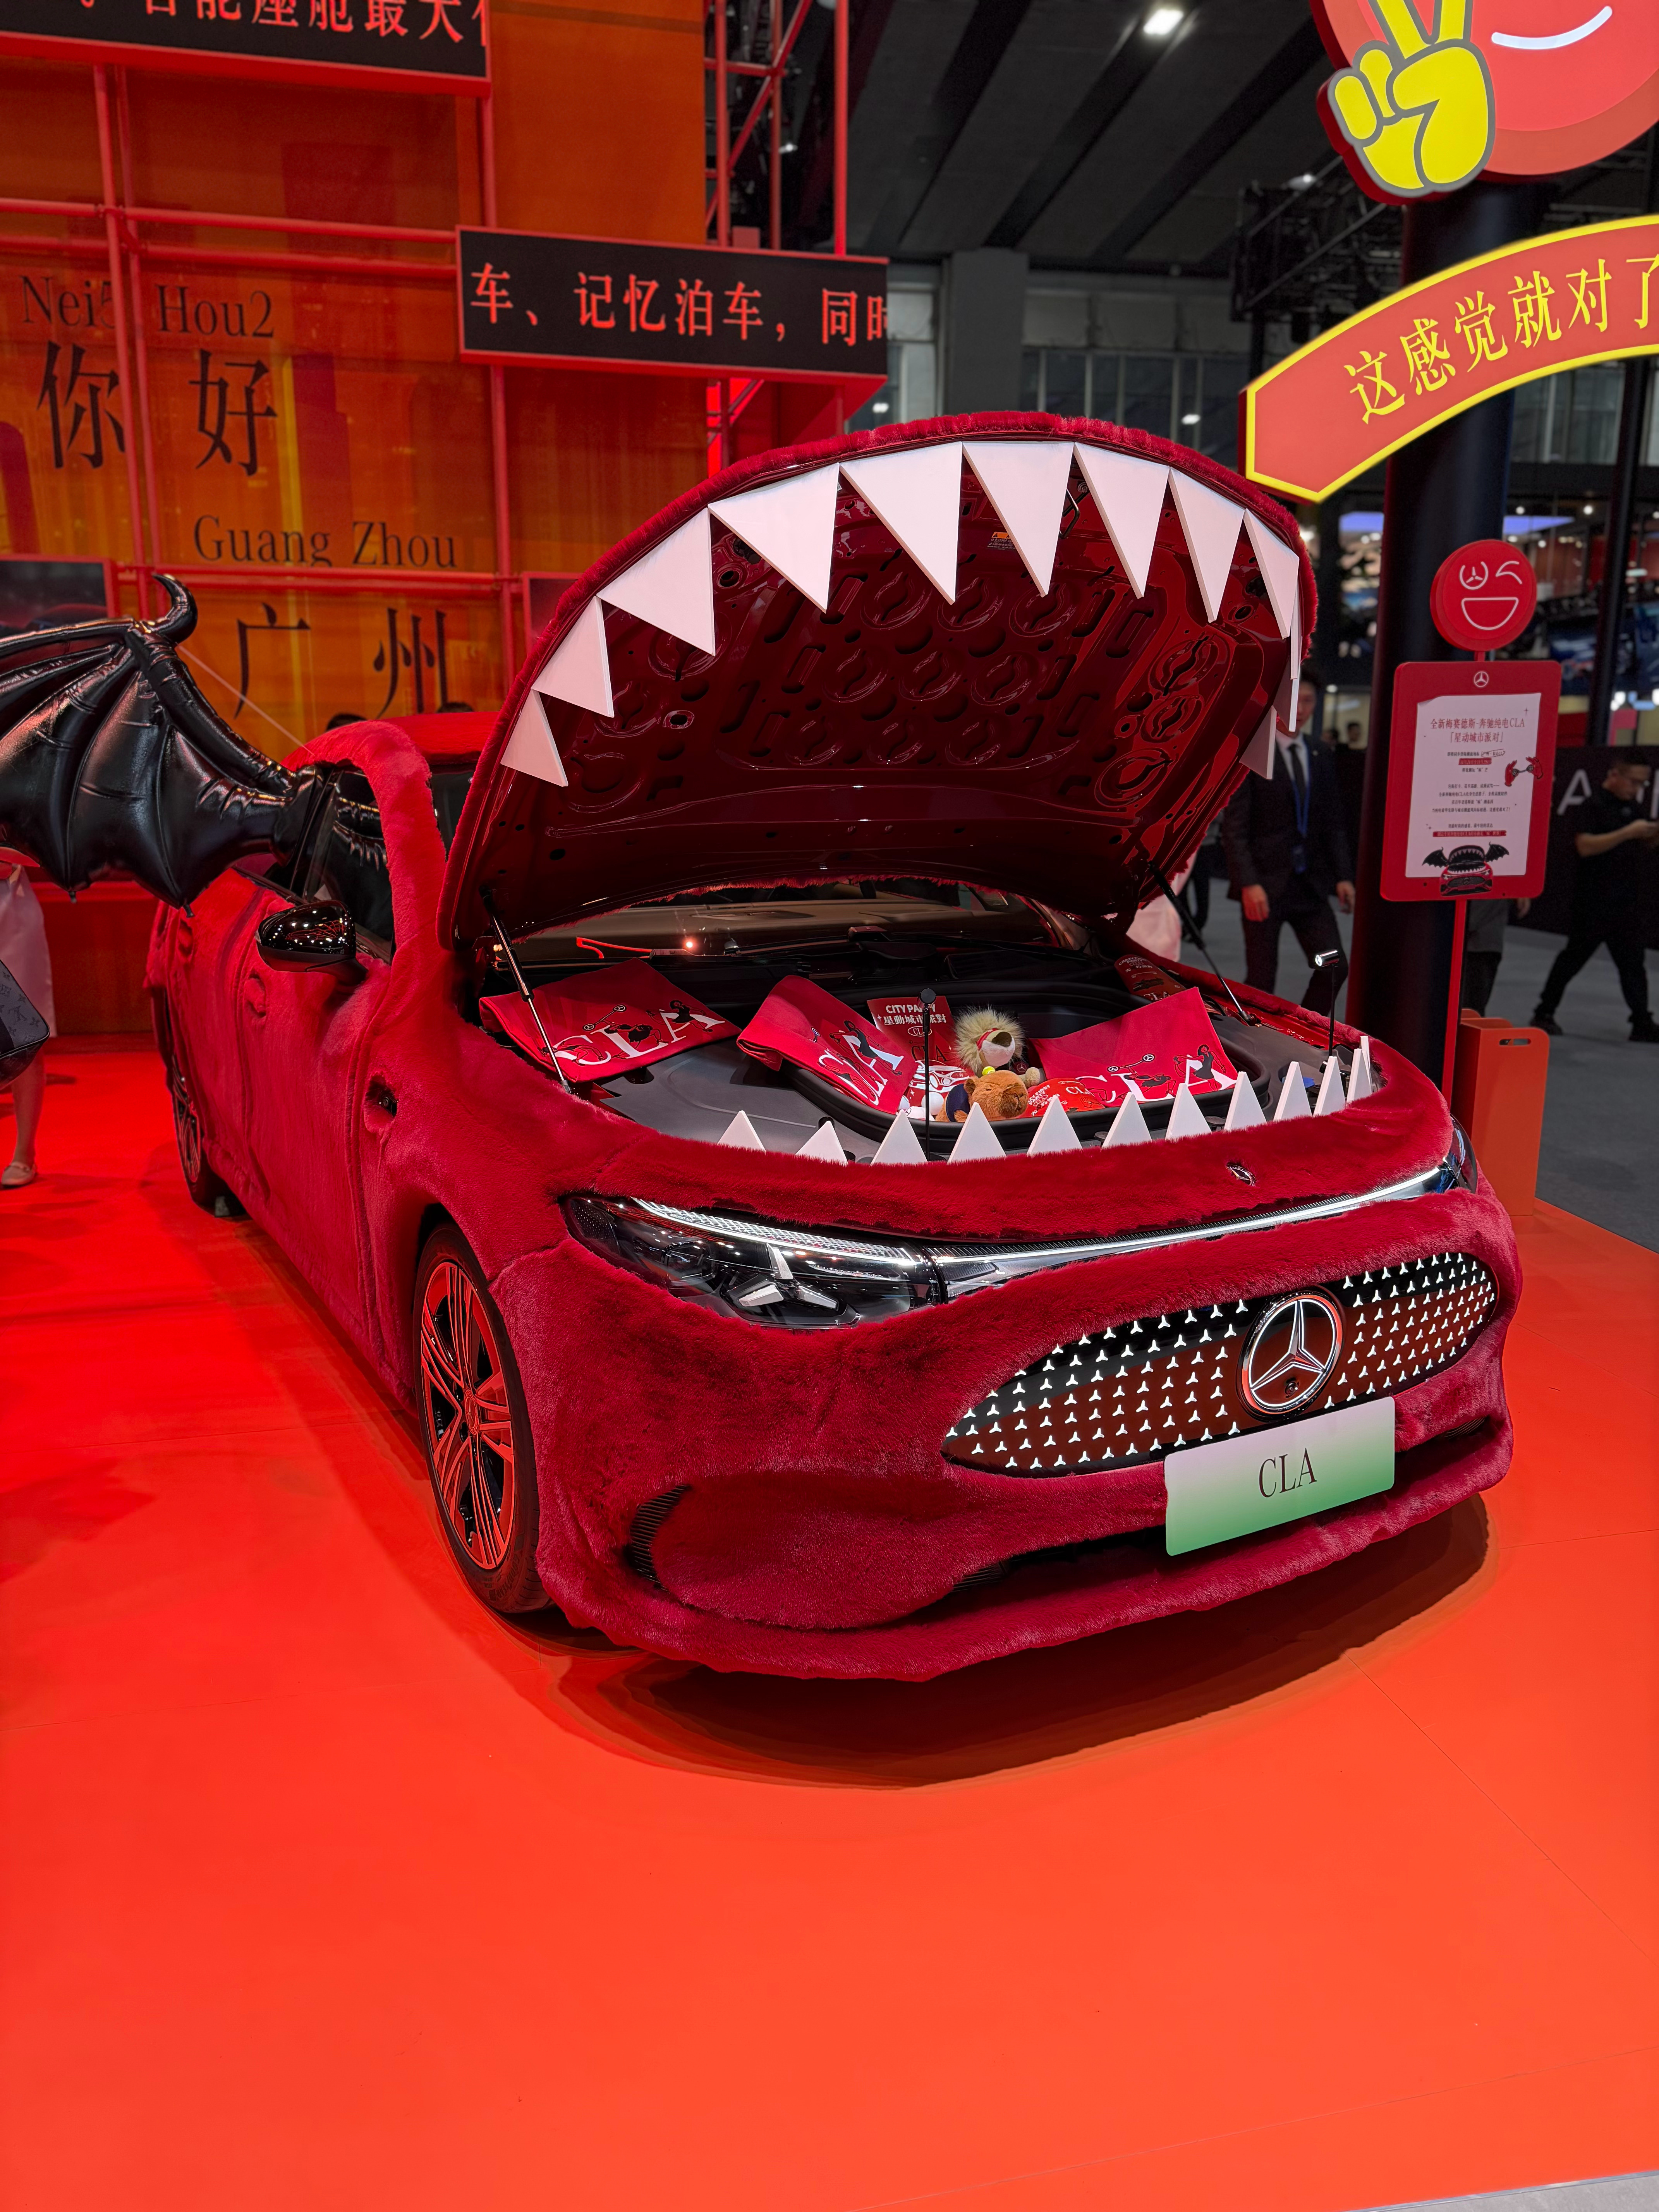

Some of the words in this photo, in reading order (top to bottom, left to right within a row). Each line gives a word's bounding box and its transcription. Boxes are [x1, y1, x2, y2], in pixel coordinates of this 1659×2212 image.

[156, 284, 274, 338] Hou2
[1343, 254, 1659, 424] 这感觉就对了
[193, 515, 331, 568] Guang
[352, 521, 458, 568] Zhou
[885, 1005, 906, 1013] CITY
[907, 1004, 936, 1013] PAY
[553, 1008, 726, 1065] CLA
[911, 1044, 949, 1062] CA
[1259, 1447, 1317, 1498] CLA
